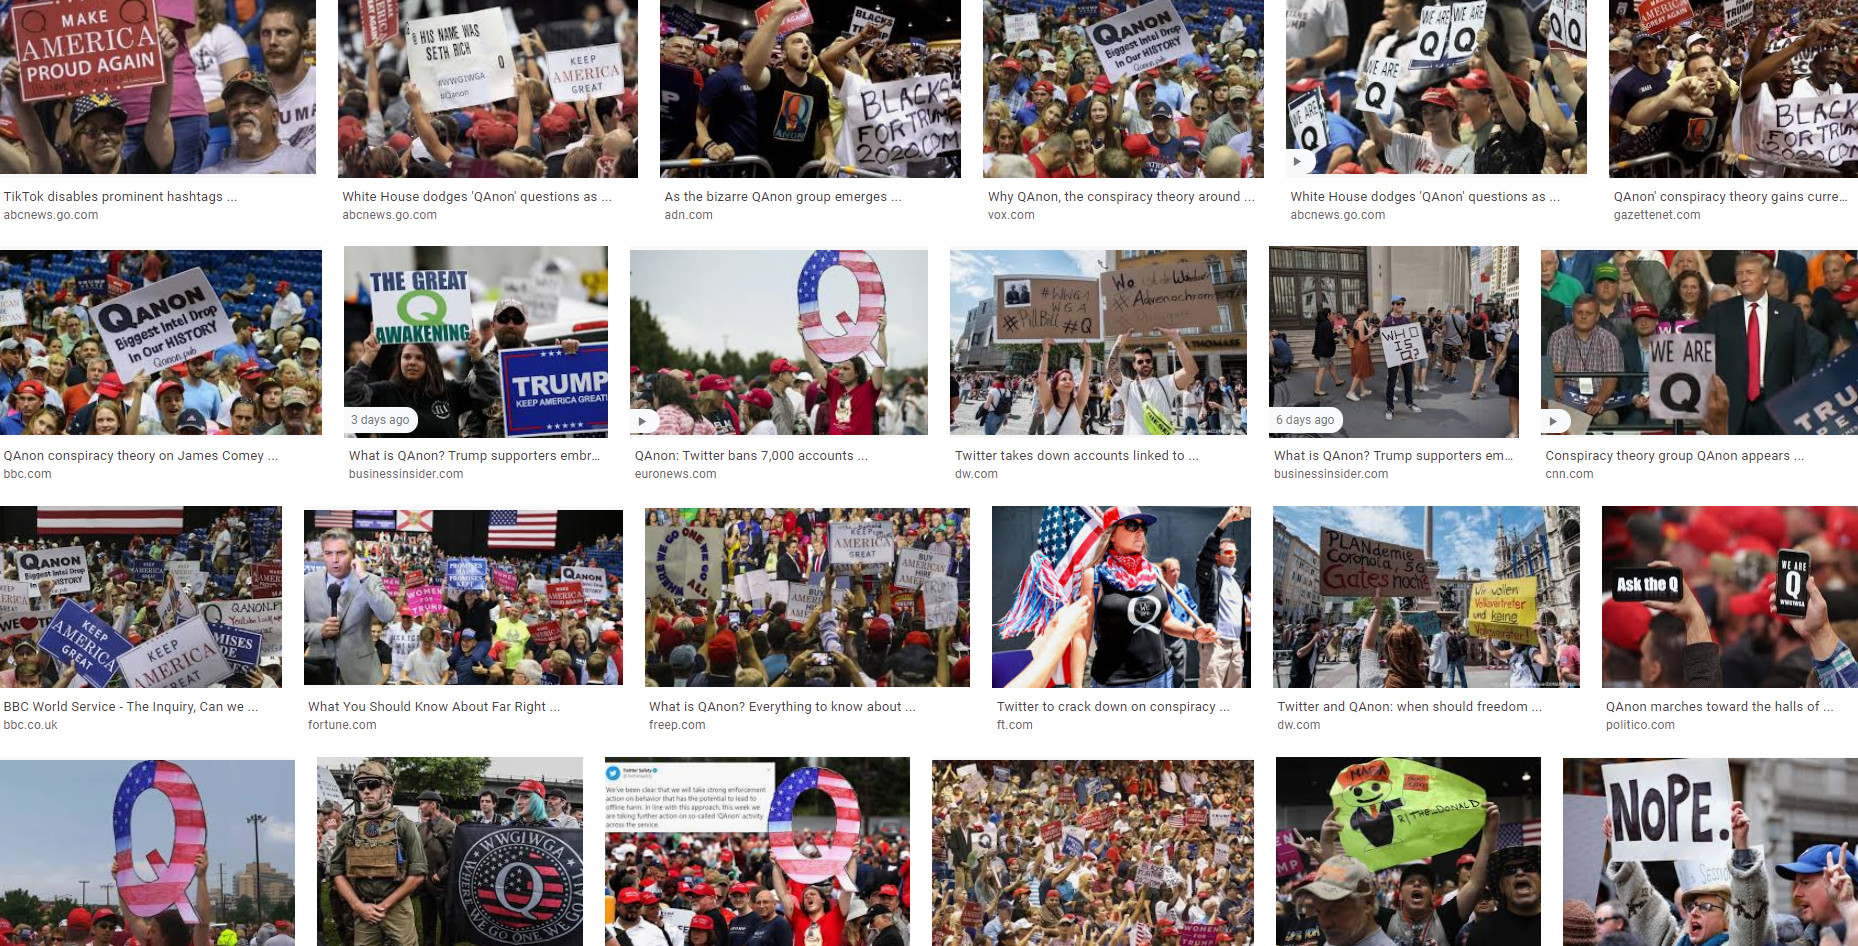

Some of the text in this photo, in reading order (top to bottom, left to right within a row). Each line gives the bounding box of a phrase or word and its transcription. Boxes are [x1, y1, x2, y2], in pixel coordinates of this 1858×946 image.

[61, 9, 108, 28] MAKE
[1422, 10, 1450, 25] WE ARE
[1453, 4, 1485, 22] WE ARE
[420, 23, 480, 44] HIS NAME WAS
[1093, 11, 1172, 46] QANON
[1568, 18, 1582, 46] Q
[21, 25, 156, 62] AMERICA
[1104, 24, 1182, 59] Biggest Intel Drop
[1125, 36, 1182, 65] Our HISTORY
[1419, 30, 1440, 57] Q
[1453, 27, 1476, 53] Q
[426, 42, 472, 61] SETH RICH
[570, 54, 597, 66] KEEP
[26, 52, 154, 82] PROUD AGAIN
[552, 66, 620, 83] AMERICA
[1367, 60, 1400, 78] WE ARE
[440, 89, 469, 101] #Qanon
[571, 82, 603, 95] GREAT
[1365, 81, 1386, 109] Q
[857, 121, 905, 144] FOR
[1301, 125, 1319, 150] Q
[857, 132, 959, 164] 2020.COM
[369, 270, 468, 292] THE GREAT
[98, 286, 206, 333] QANON
[397, 290, 447, 326] Q
[797, 250, 887, 367] Q
[115, 304, 218, 351] Biggest Intel Drop
[376, 324, 471, 345] AWAKENING
[1381, 326, 1419, 341] WHO
[128, 321, 218, 364] In Our HISTORY
[1394, 339, 1413, 350] IS
[1651, 340, 1712, 363] WE ARE
[512, 371, 608, 397] TRUMP
[1659, 372, 1700, 413] Q
[515, 394, 608, 409] KEEP AMERICA GREAT!
[665, 529, 680, 544] GO
[682, 527, 705, 544] ONE
[833, 537, 891, 548] AMERICA
[1325, 530, 1413, 561] PLANdemie
[19, 553, 81, 571] QANON
[656, 543, 668, 562] WE
[849, 550, 876, 559] GREAT
[918, 553, 934, 561] BUY
[563, 568, 602, 581] QANON
[699, 563, 708, 581] GO
[1782, 559, 1807, 571] WE ARE
[656, 565, 684, 597] WHERE
[686, 578, 708, 598] ALL
[1322, 564, 1429, 591] Gates noch?
[1617, 577, 1678, 592] Ask the Q
[1785, 571, 1800, 599] Q
[407, 587, 442, 598] WOMEN
[1475, 584, 1519, 596] Wir wollen
[412, 603, 447, 614] TRUMP
[1127, 596, 1161, 634] Q
[1473, 610, 1518, 622] und keine
[81, 619, 108, 641] KEEP
[52, 620, 117, 674] AMERICA
[61, 645, 94, 671] GREAT
[148, 639, 178, 662] KEEP
[133, 642, 217, 688] AMERICA
[1350, 765, 1386, 781] MAGA
[1609, 773, 1730, 842] NOPE.
[768, 767, 861, 892] Q
[113, 760, 207, 924] Q
[979, 834, 991, 849] Q
[461, 860, 583, 944] WHERE WE GO ONE WE GO
[495, 862, 543, 920] Q
